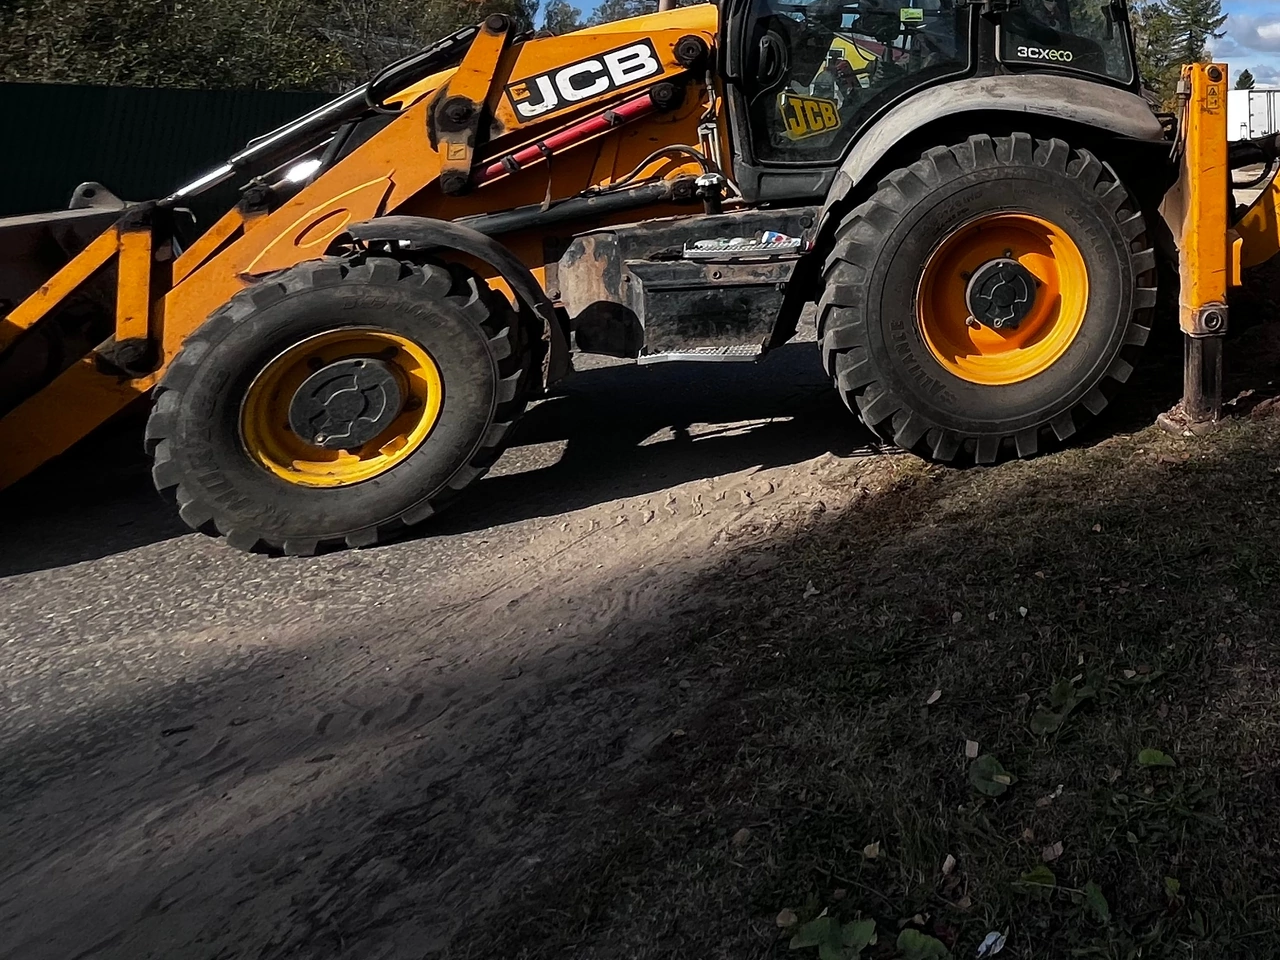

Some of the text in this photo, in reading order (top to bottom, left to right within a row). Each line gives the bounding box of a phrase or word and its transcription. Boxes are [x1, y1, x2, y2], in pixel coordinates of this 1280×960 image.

[1017, 46, 1073, 62] 3CXeco
[516, 43, 658, 118] JCB
[788, 97, 837, 135] JCB
[1084, 226, 1107, 265] PLUS
[889, 319, 947, 396] ALLIANCE
